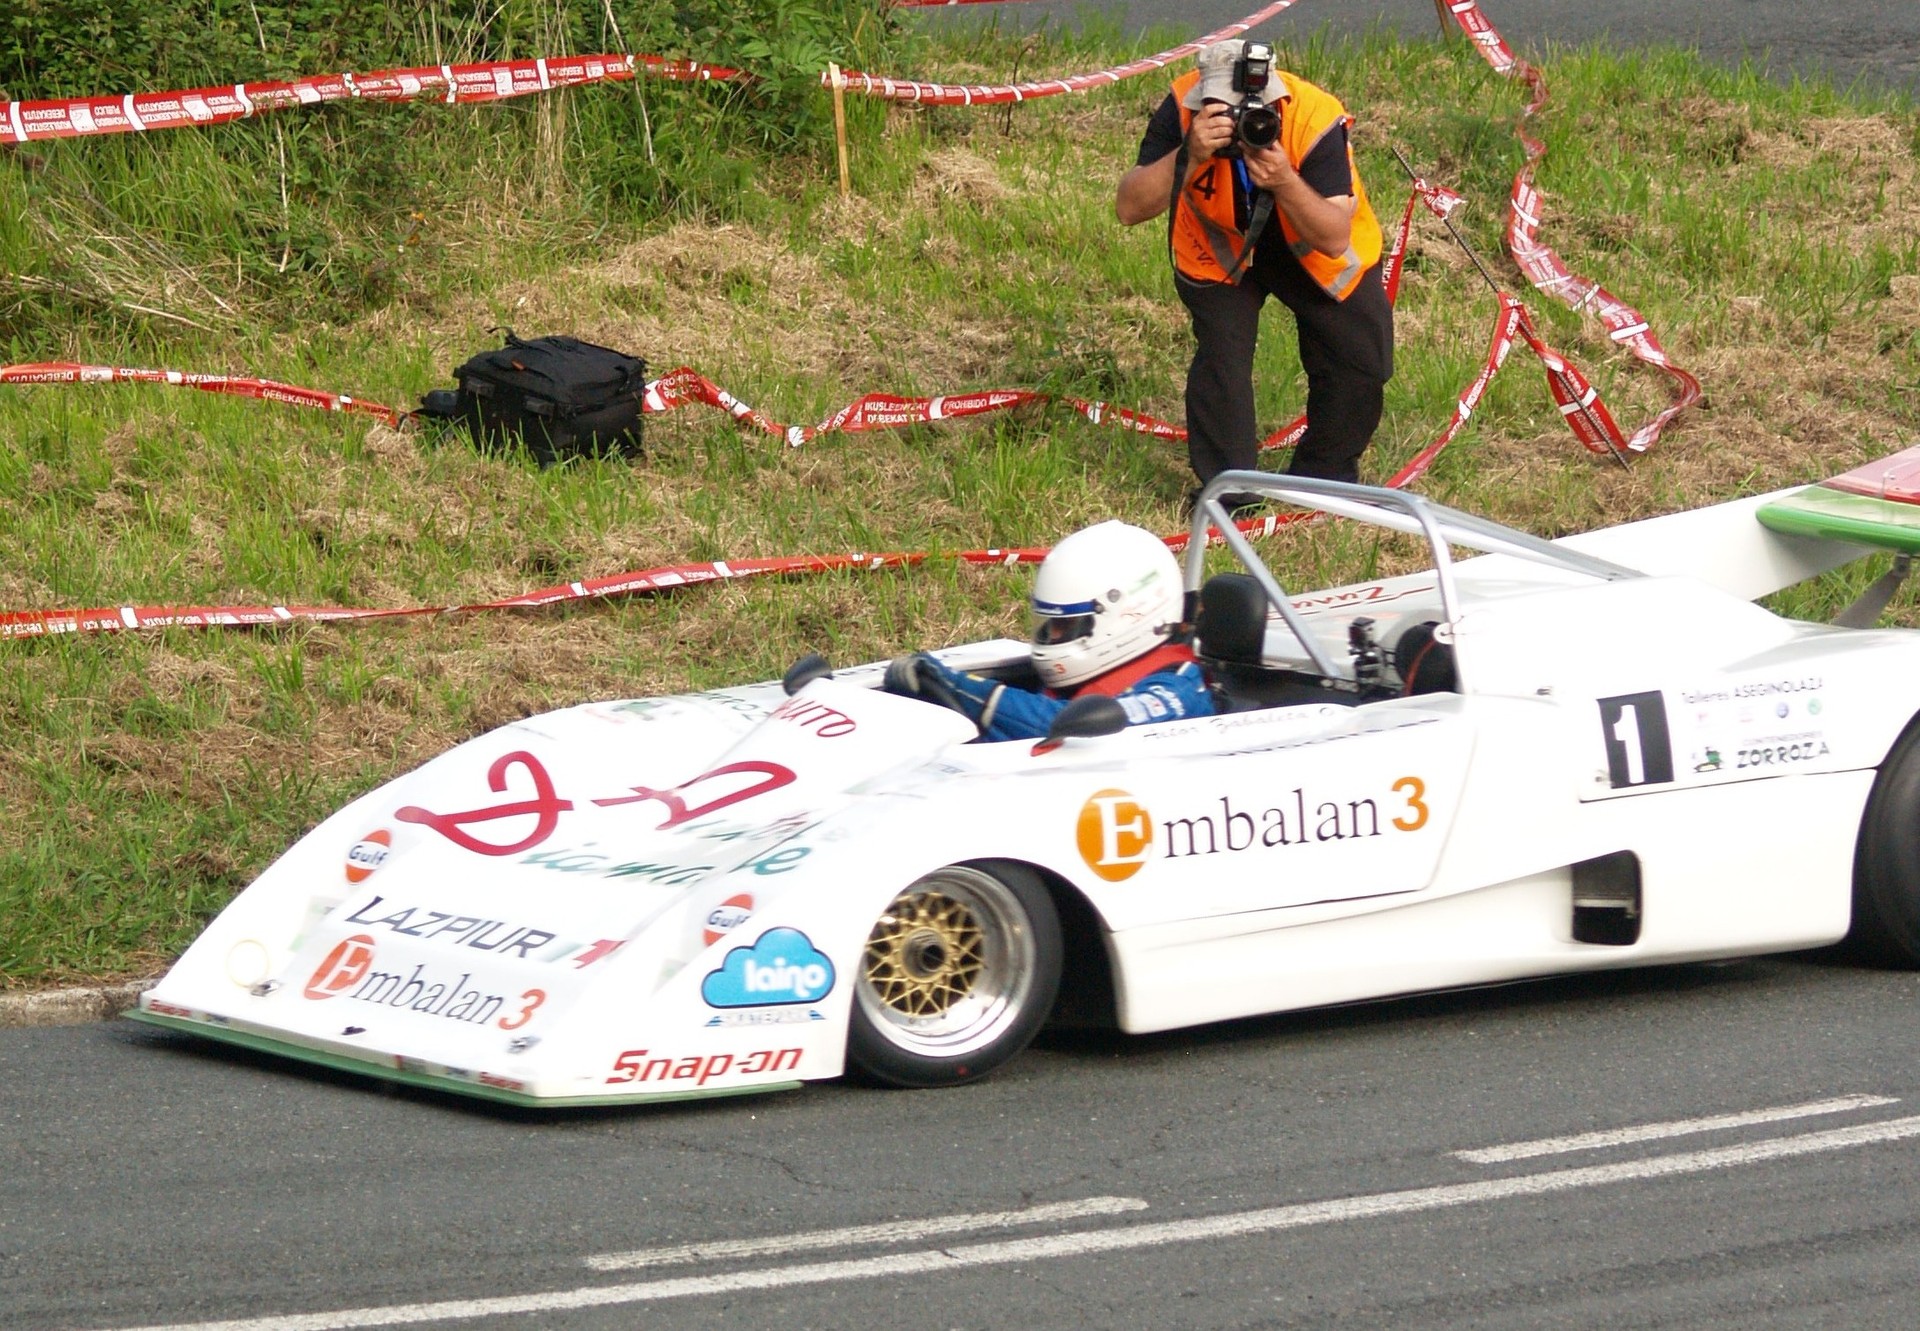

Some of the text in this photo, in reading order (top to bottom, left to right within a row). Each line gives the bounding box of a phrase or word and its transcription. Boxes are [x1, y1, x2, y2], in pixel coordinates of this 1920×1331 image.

[1192, 164, 1216, 201] 4
[261, 388, 324, 408] DEBEKATUTA
[942, 398, 987, 411] PROHIBIDO
[1613, 704, 1645, 784] 1
[1736, 741, 1831, 769] ZORROZA
[348, 844, 388, 866] Gulf
[344, 896, 557, 959] LAZPIUR
[604, 1047, 804, 1086] Snap-on
